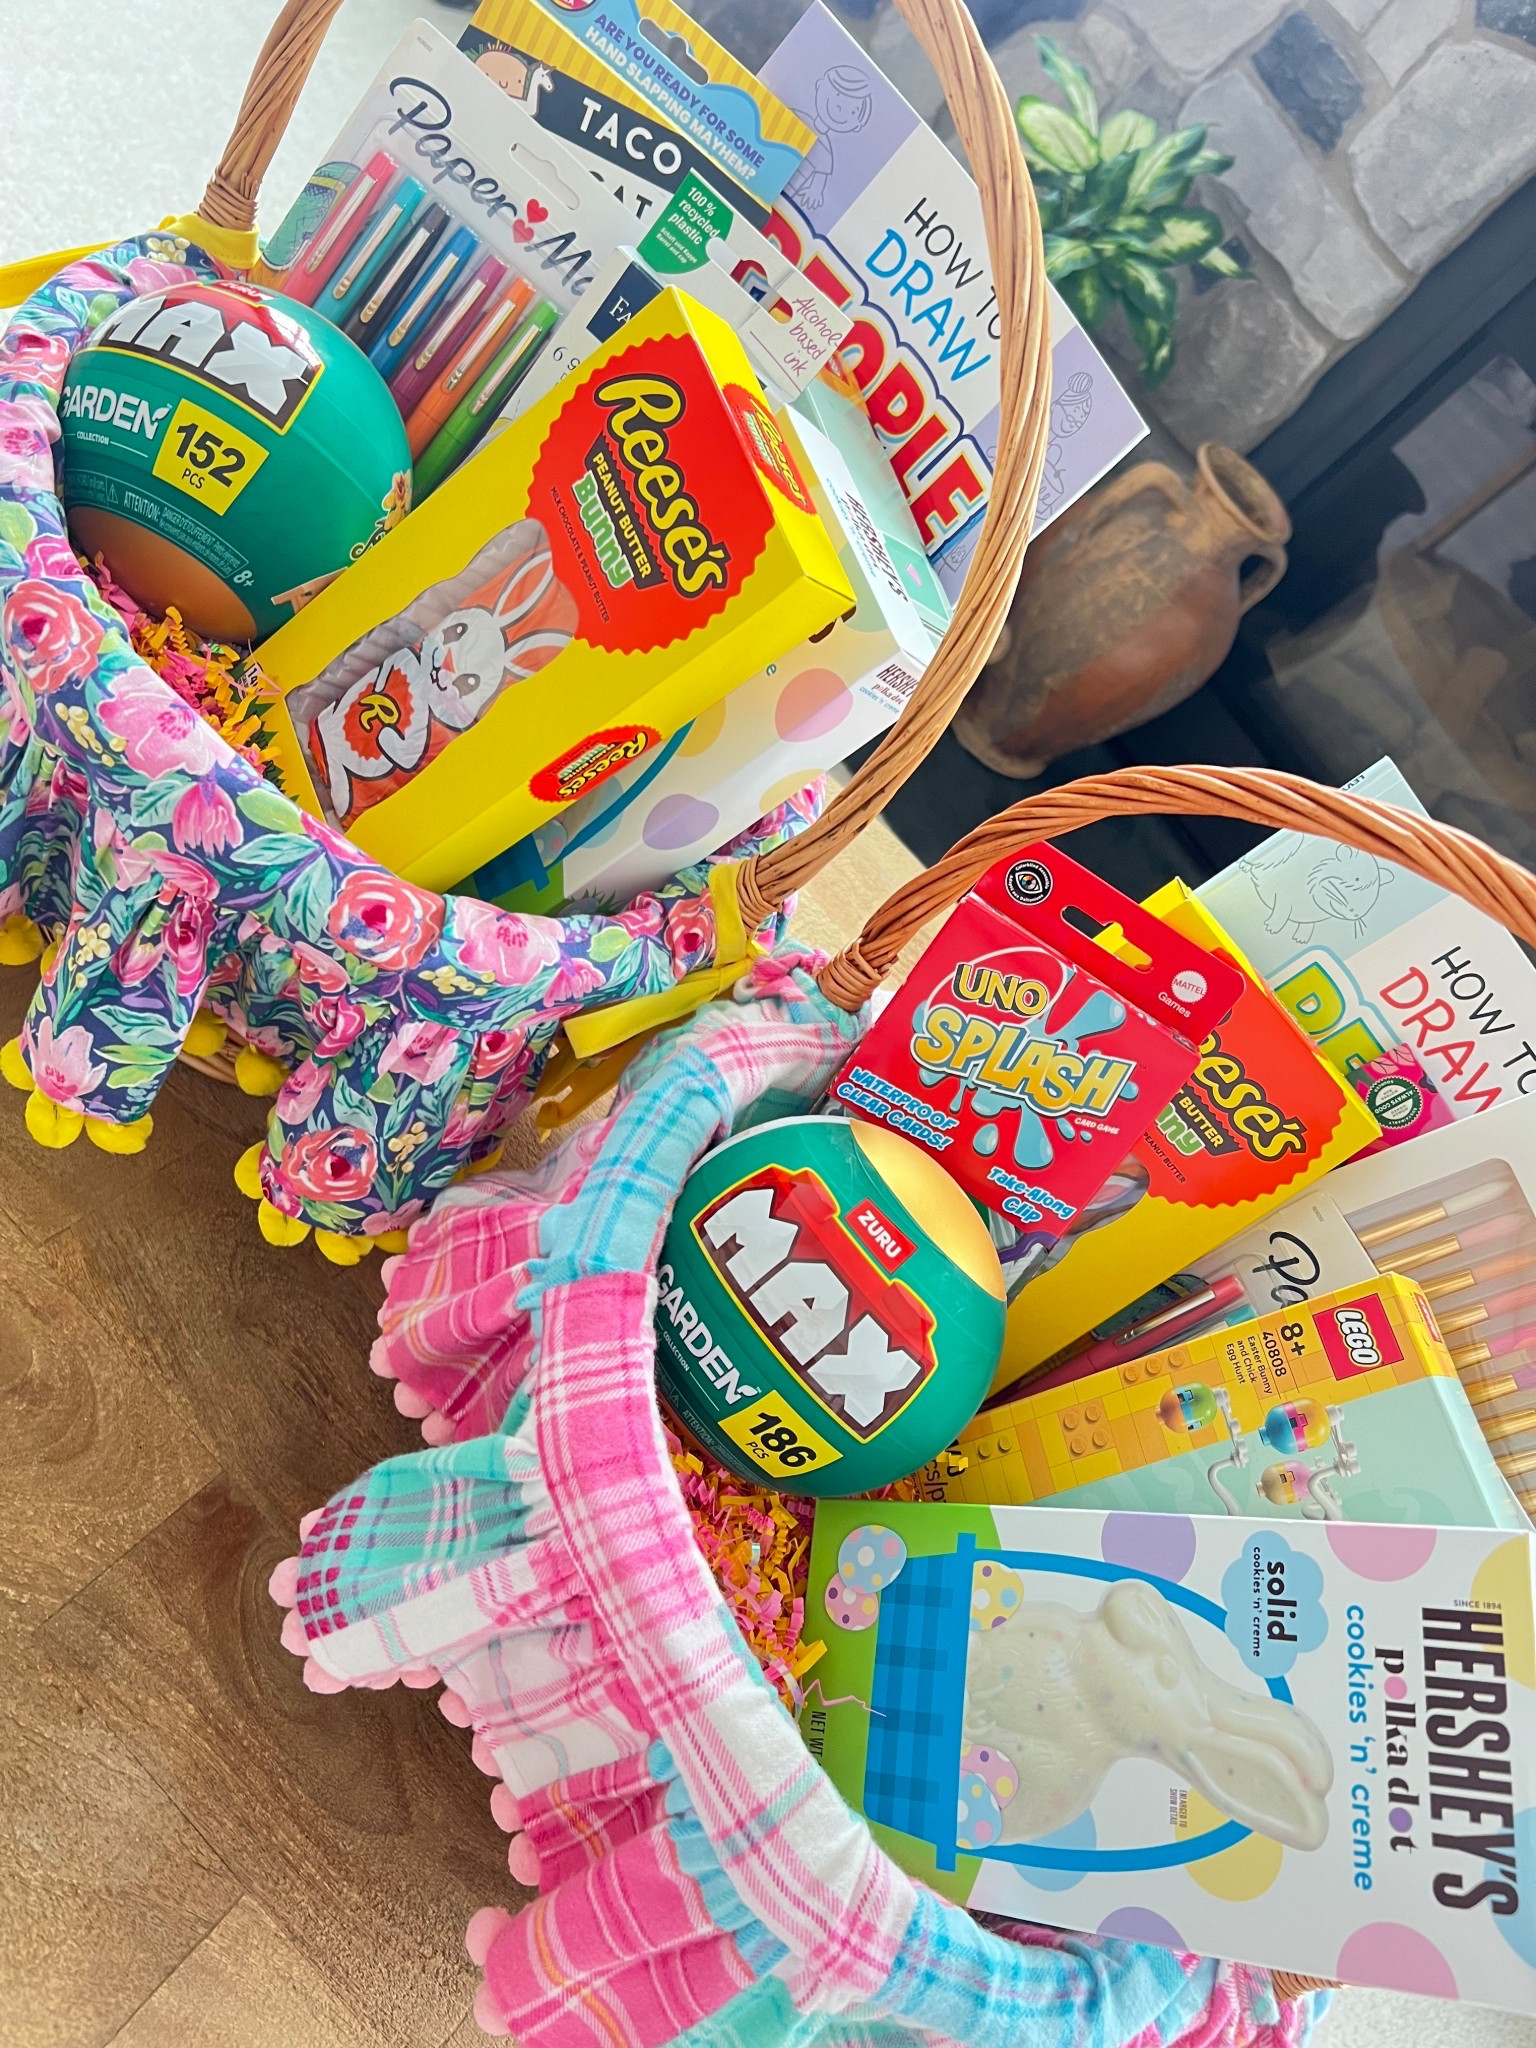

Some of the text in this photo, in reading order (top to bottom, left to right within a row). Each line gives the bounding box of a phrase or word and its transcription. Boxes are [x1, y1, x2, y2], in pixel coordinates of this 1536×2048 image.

[585, 25, 756, 180] HAND SLAPPING MAYHEM?
[594, 14, 765, 168] ARE YOU READY FOR SOME
[389, 77, 518, 217] Paper
[580, 97, 682, 175] TACO
[678, 200, 721, 238] recycled
[688, 187, 717, 217] 100 %
[667, 213, 703, 245] plastic
[904, 197, 984, 289] HOW
[865, 228, 991, 382] DRAW
[783, 350, 808, 377] ink
[789, 321, 826, 360] based
[61, 385, 165, 440] GARDEN
[76, 430, 110, 445] COLLECTION
[176, 422, 246, 488] 152
[181, 467, 206, 489] PCS
[123, 491, 161, 523] ATTENTION:
[598, 377, 727, 596] Reese's
[593, 452, 652, 578] PEANUT BUTTER
[551, 487, 561, 508] MILK
[558, 507, 582, 552] CHOCOLATE
[580, 557, 597, 595] PEANUT
[594, 592, 610, 623] BUTTER
[845, 491, 908, 602] HERSHEY'S
[233, 570, 255, 587] 8+
[358, 692, 401, 733] R
[558, 732, 647, 797] Reese's
[955, 963, 1048, 1017] UNO
[1158, 991, 1192, 1018] Games
[1173, 979, 1205, 996] MATTEL
[1431, 945, 1516, 1035] HOW
[914, 1007, 1135, 1116] SPLASH
[1379, 966, 1502, 1114] DRAW
[837, 1083, 954, 1151] CLEAR CARDS!
[849, 1067, 959, 1131] WATERPROOF
[1179, 1094, 1224, 1147] BUTTER
[1391, 1089, 1414, 1106] ALWAYS
[1074, 1117, 1120, 1135] CARD GAME
[1143, 1131, 1186, 1184] PEANUT BUTTER
[988, 1166, 1076, 1220] Take-Along
[1002, 1196, 1042, 1225] Clip
[857, 1210, 902, 1259] ZURU
[657, 1264, 745, 1405] GARDEN
[703, 1189, 921, 1427] MAX
[663, 1331, 691, 1372] COLLECTION
[1226, 1343, 1246, 1385] Egg Hunt
[1237, 1340, 1257, 1384] and Chick
[1262, 1331, 1287, 1378] 40808
[1280, 1322, 1306, 1356] 8+
[1334, 1308, 1382, 1368] LEGO
[1247, 1336, 1273, 1395] Easter Bunny
[746, 1441, 770, 1460] PCS
[748, 1411, 817, 1468] 186
[1253, 1546, 1264, 1594] cookies
[1266, 1560, 1298, 1643] solid
[1453, 1599, 1502, 1610] SINCE 1894
[1252, 1616, 1261, 1658] creme
[1346, 1604, 1377, 1725] cookies
[809, 1710, 826, 1758] NET WT
[1374, 1646, 1421, 1855] polka dot
[1421, 1607, 1519, 1916] HERSHEY'S
[1170, 1788, 1178, 1825] SHOW DETAIL
[1179, 1789, 1188, 1828] ENLARGED TO
[1351, 1783, 1373, 1892] creme
